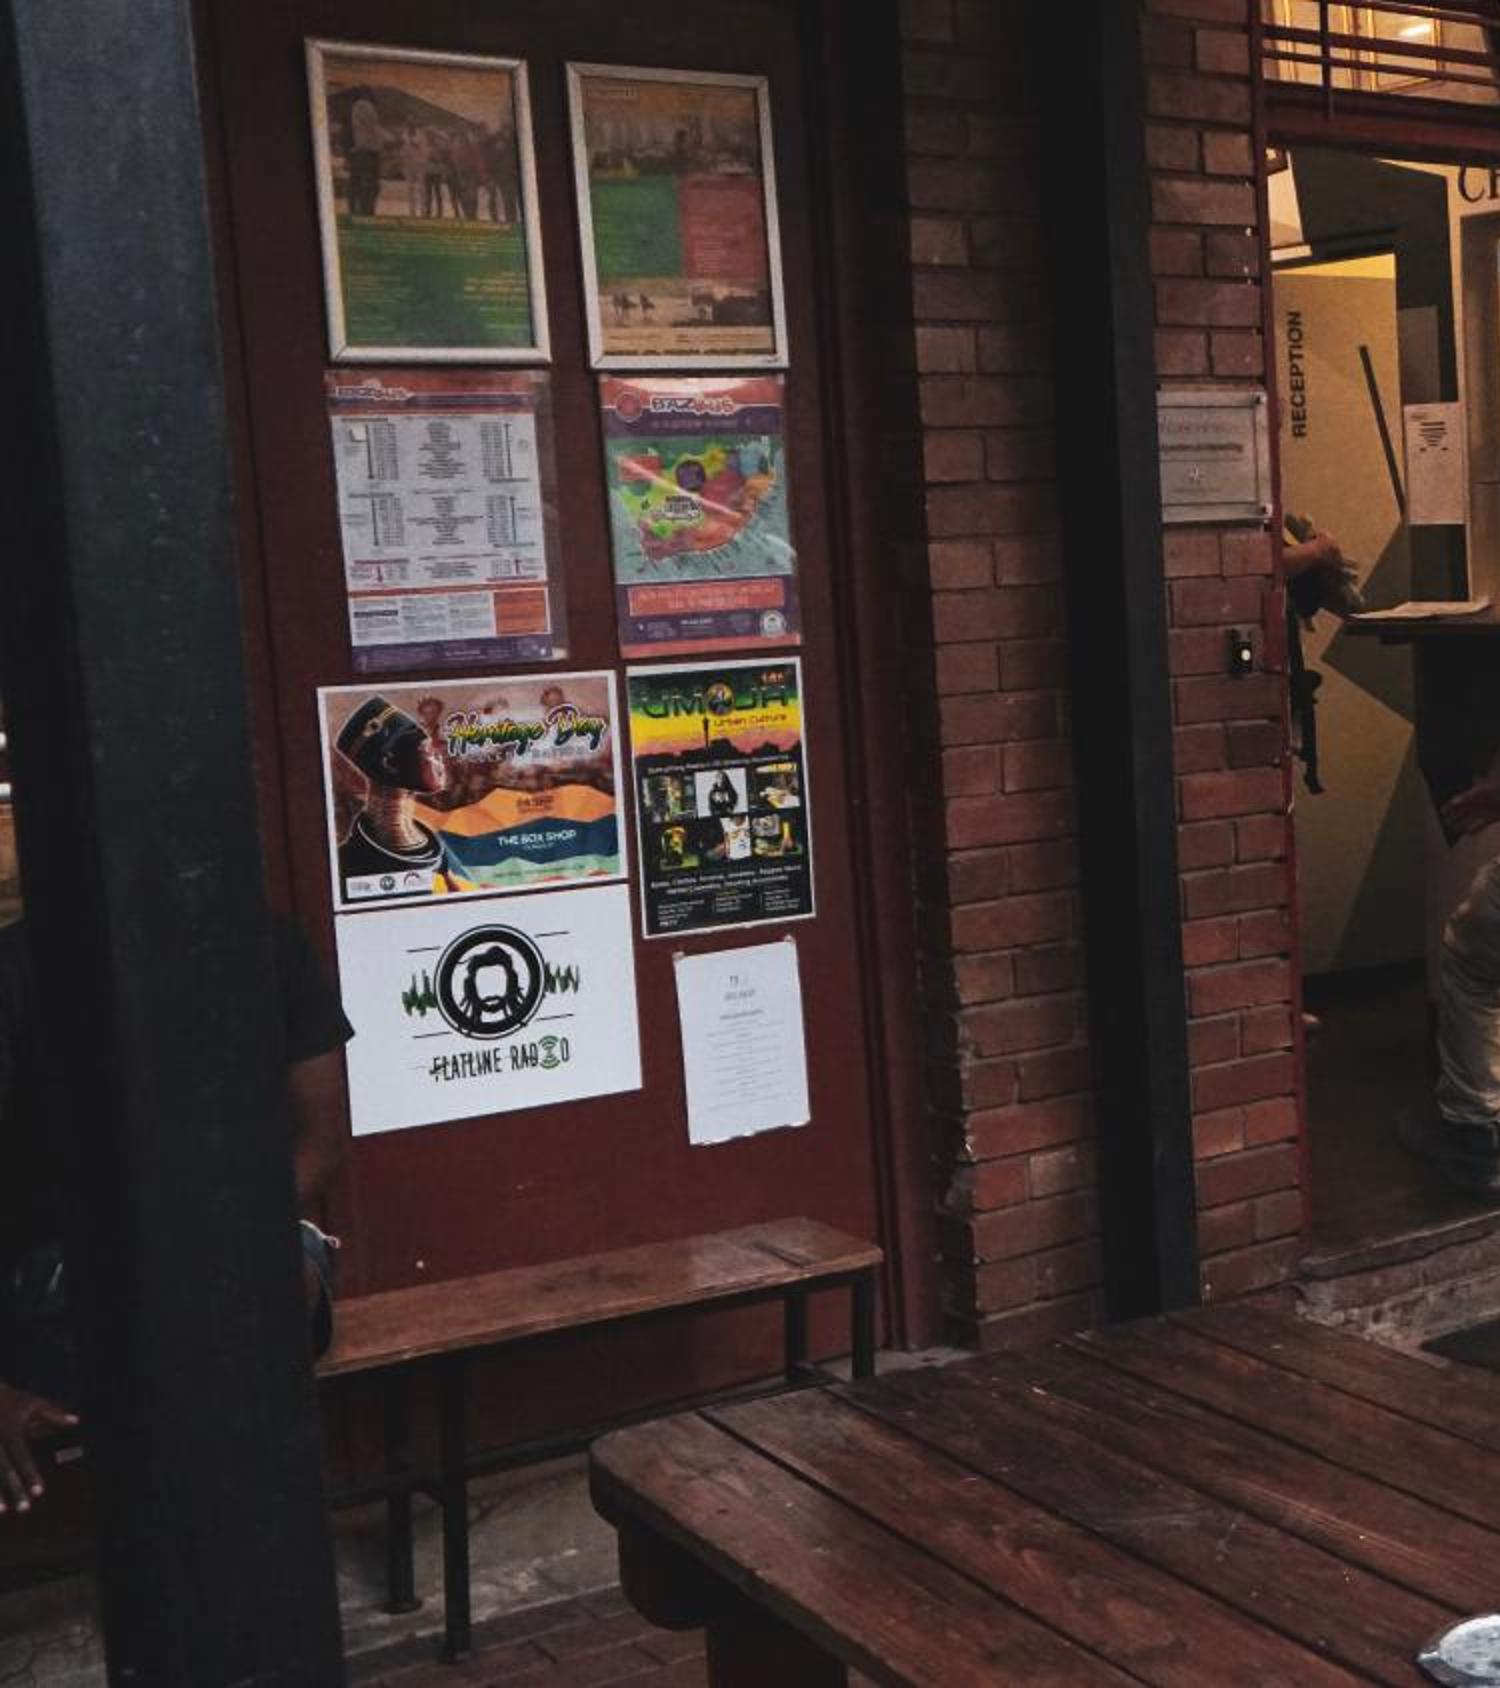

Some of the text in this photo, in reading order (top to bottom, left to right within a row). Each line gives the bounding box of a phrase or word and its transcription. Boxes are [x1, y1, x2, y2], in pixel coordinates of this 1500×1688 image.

[1287, 310, 1306, 438] RECEPTION
[547, 704, 607, 751] Day
[497, 834, 519, 847] THE
[521, 832, 544, 844] BOX
[545, 829, 577, 842] SHOP
[428, 1047, 503, 1082] FLATLINE
